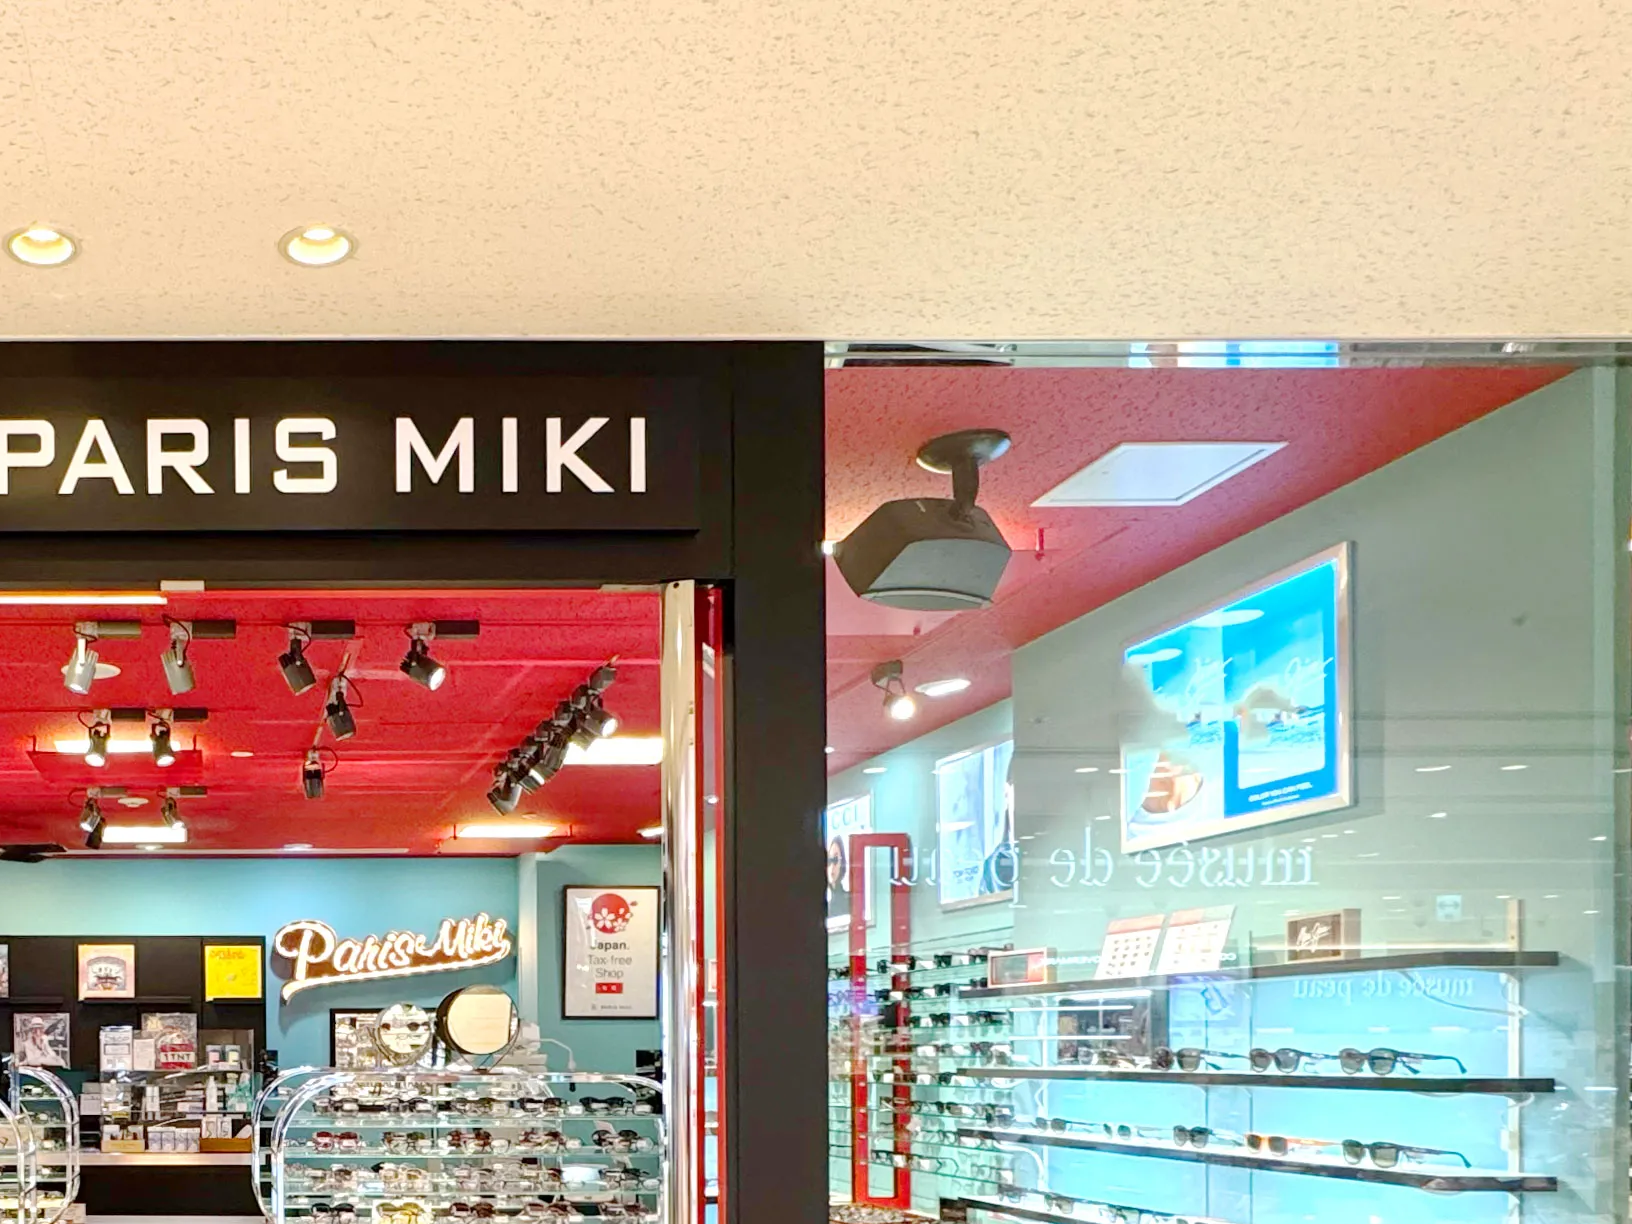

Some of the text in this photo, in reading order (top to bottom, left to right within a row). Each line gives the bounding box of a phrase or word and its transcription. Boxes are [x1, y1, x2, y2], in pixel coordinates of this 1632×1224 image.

[393, 416, 648, 494] MIKI
[274, 911, 510, 981] Paris Miki
